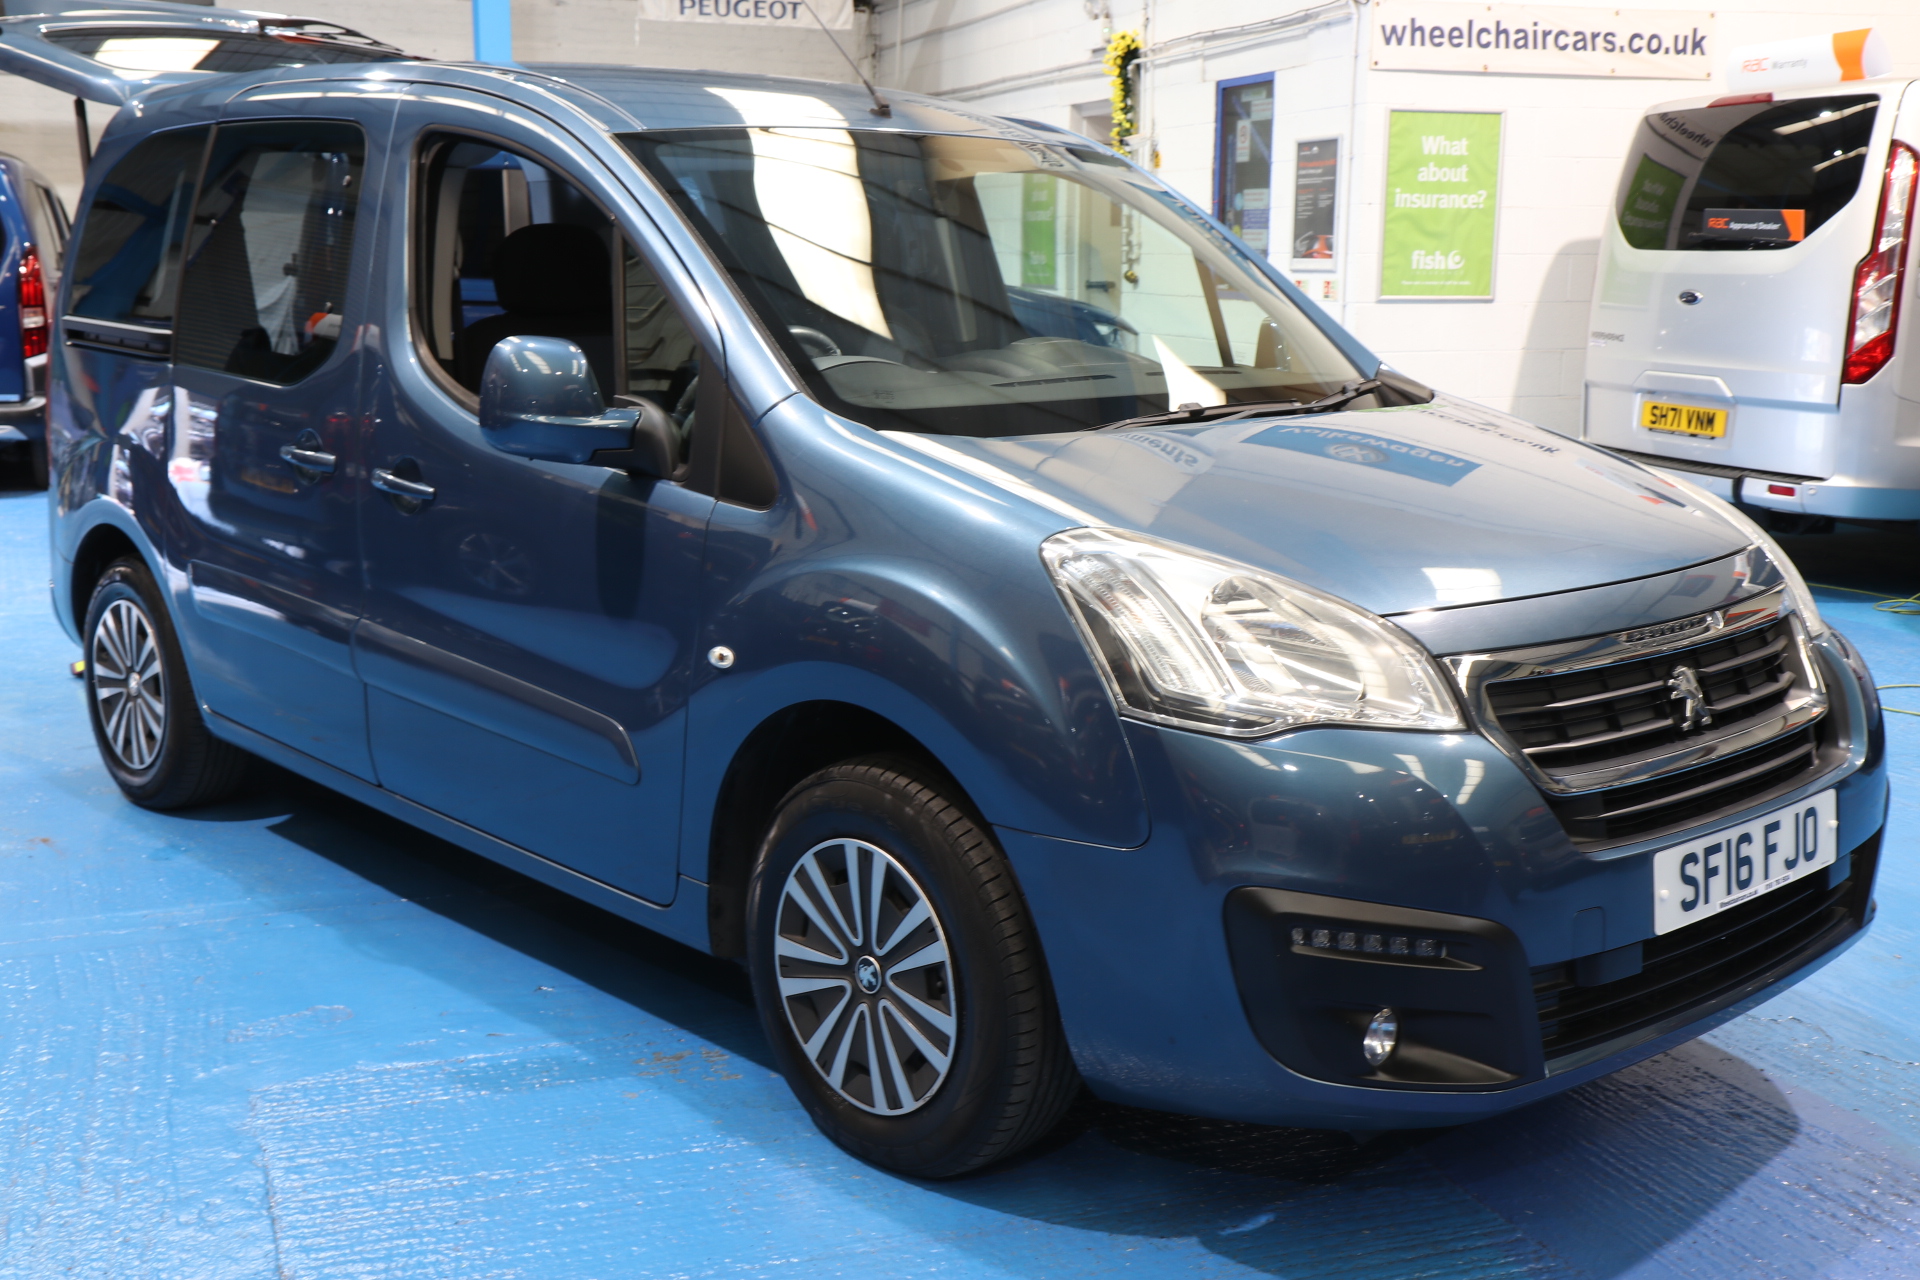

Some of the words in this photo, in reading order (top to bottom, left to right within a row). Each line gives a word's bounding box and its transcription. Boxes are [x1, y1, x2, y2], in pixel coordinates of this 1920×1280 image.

[679, 0, 801, 20] PEUGEOT
[1381, 18, 1707, 56] wheelchaircars.co.uk
[1421, 135, 1469, 155] What
[1417, 162, 1469, 182] about
[1394, 188, 1487, 209] insurance?
[1411, 249, 1446, 270] fish
[1649, 404, 1682, 427] SH71
[1686, 409, 1717, 433] VNM
[1680, 832, 1754, 913] SF16
[1764, 806, 1818, 880] FJO
